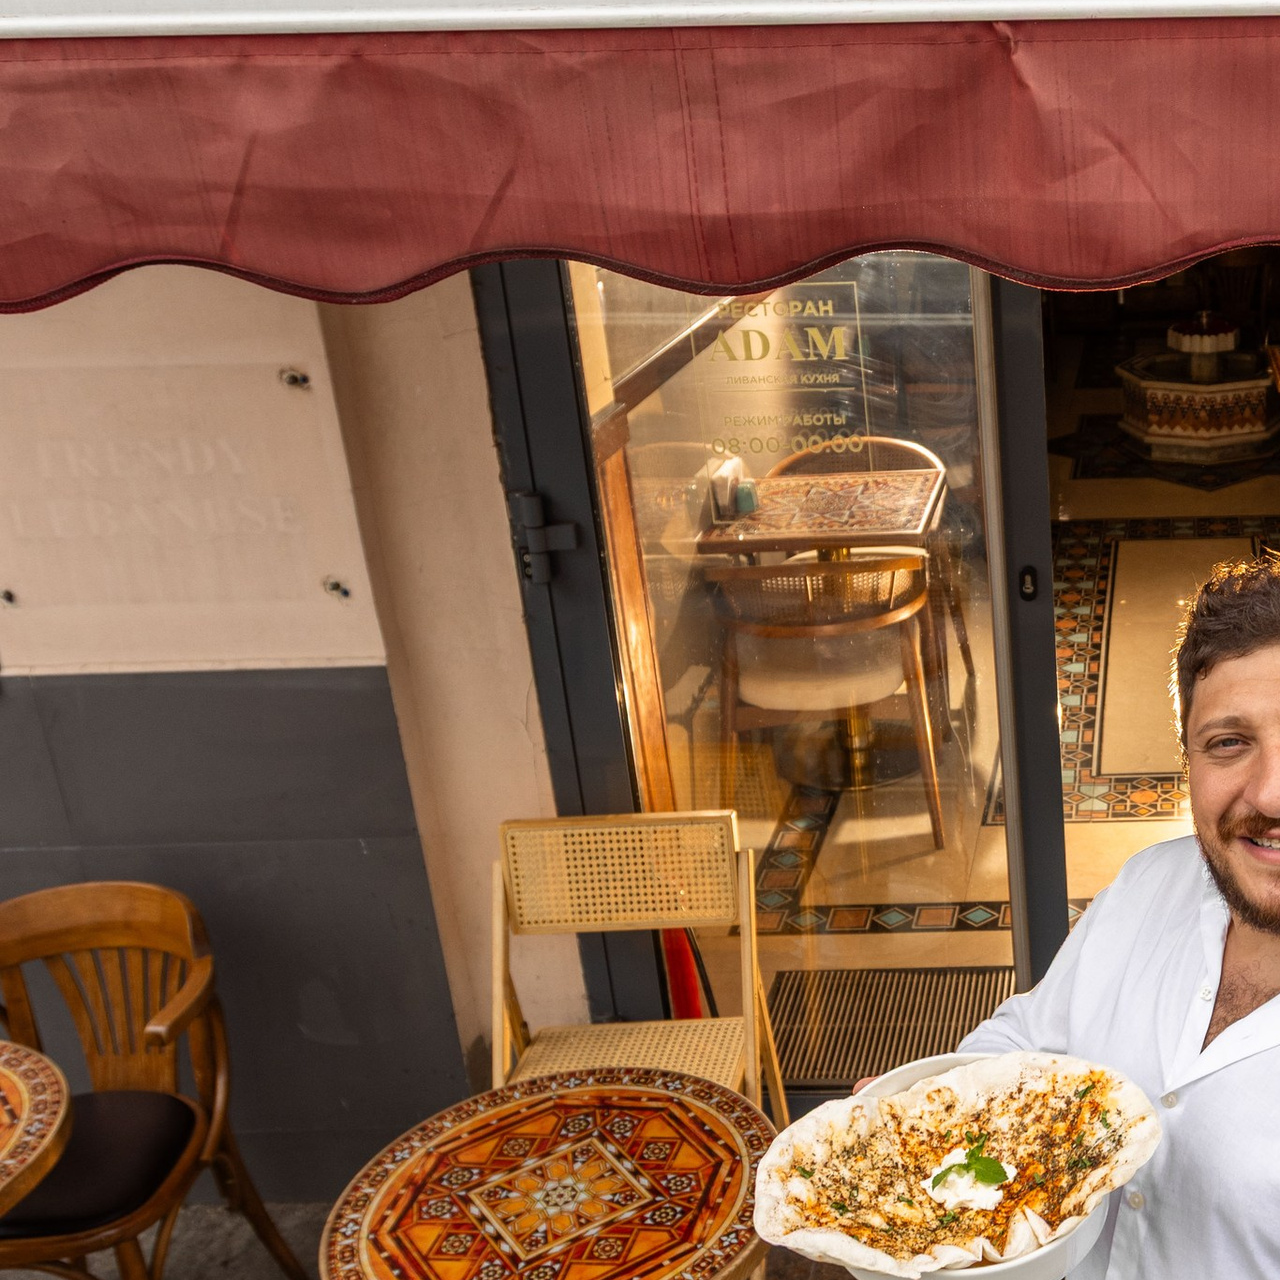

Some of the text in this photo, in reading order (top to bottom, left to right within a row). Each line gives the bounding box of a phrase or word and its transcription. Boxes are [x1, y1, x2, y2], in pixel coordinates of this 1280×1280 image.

[718, 300, 834, 319] РЕСТОРАН
[709, 326, 850, 362] ADAM
[801, 373, 840, 384] КУХНЯ
[724, 413, 847, 427] РЕЖИМ РАБОТЫ
